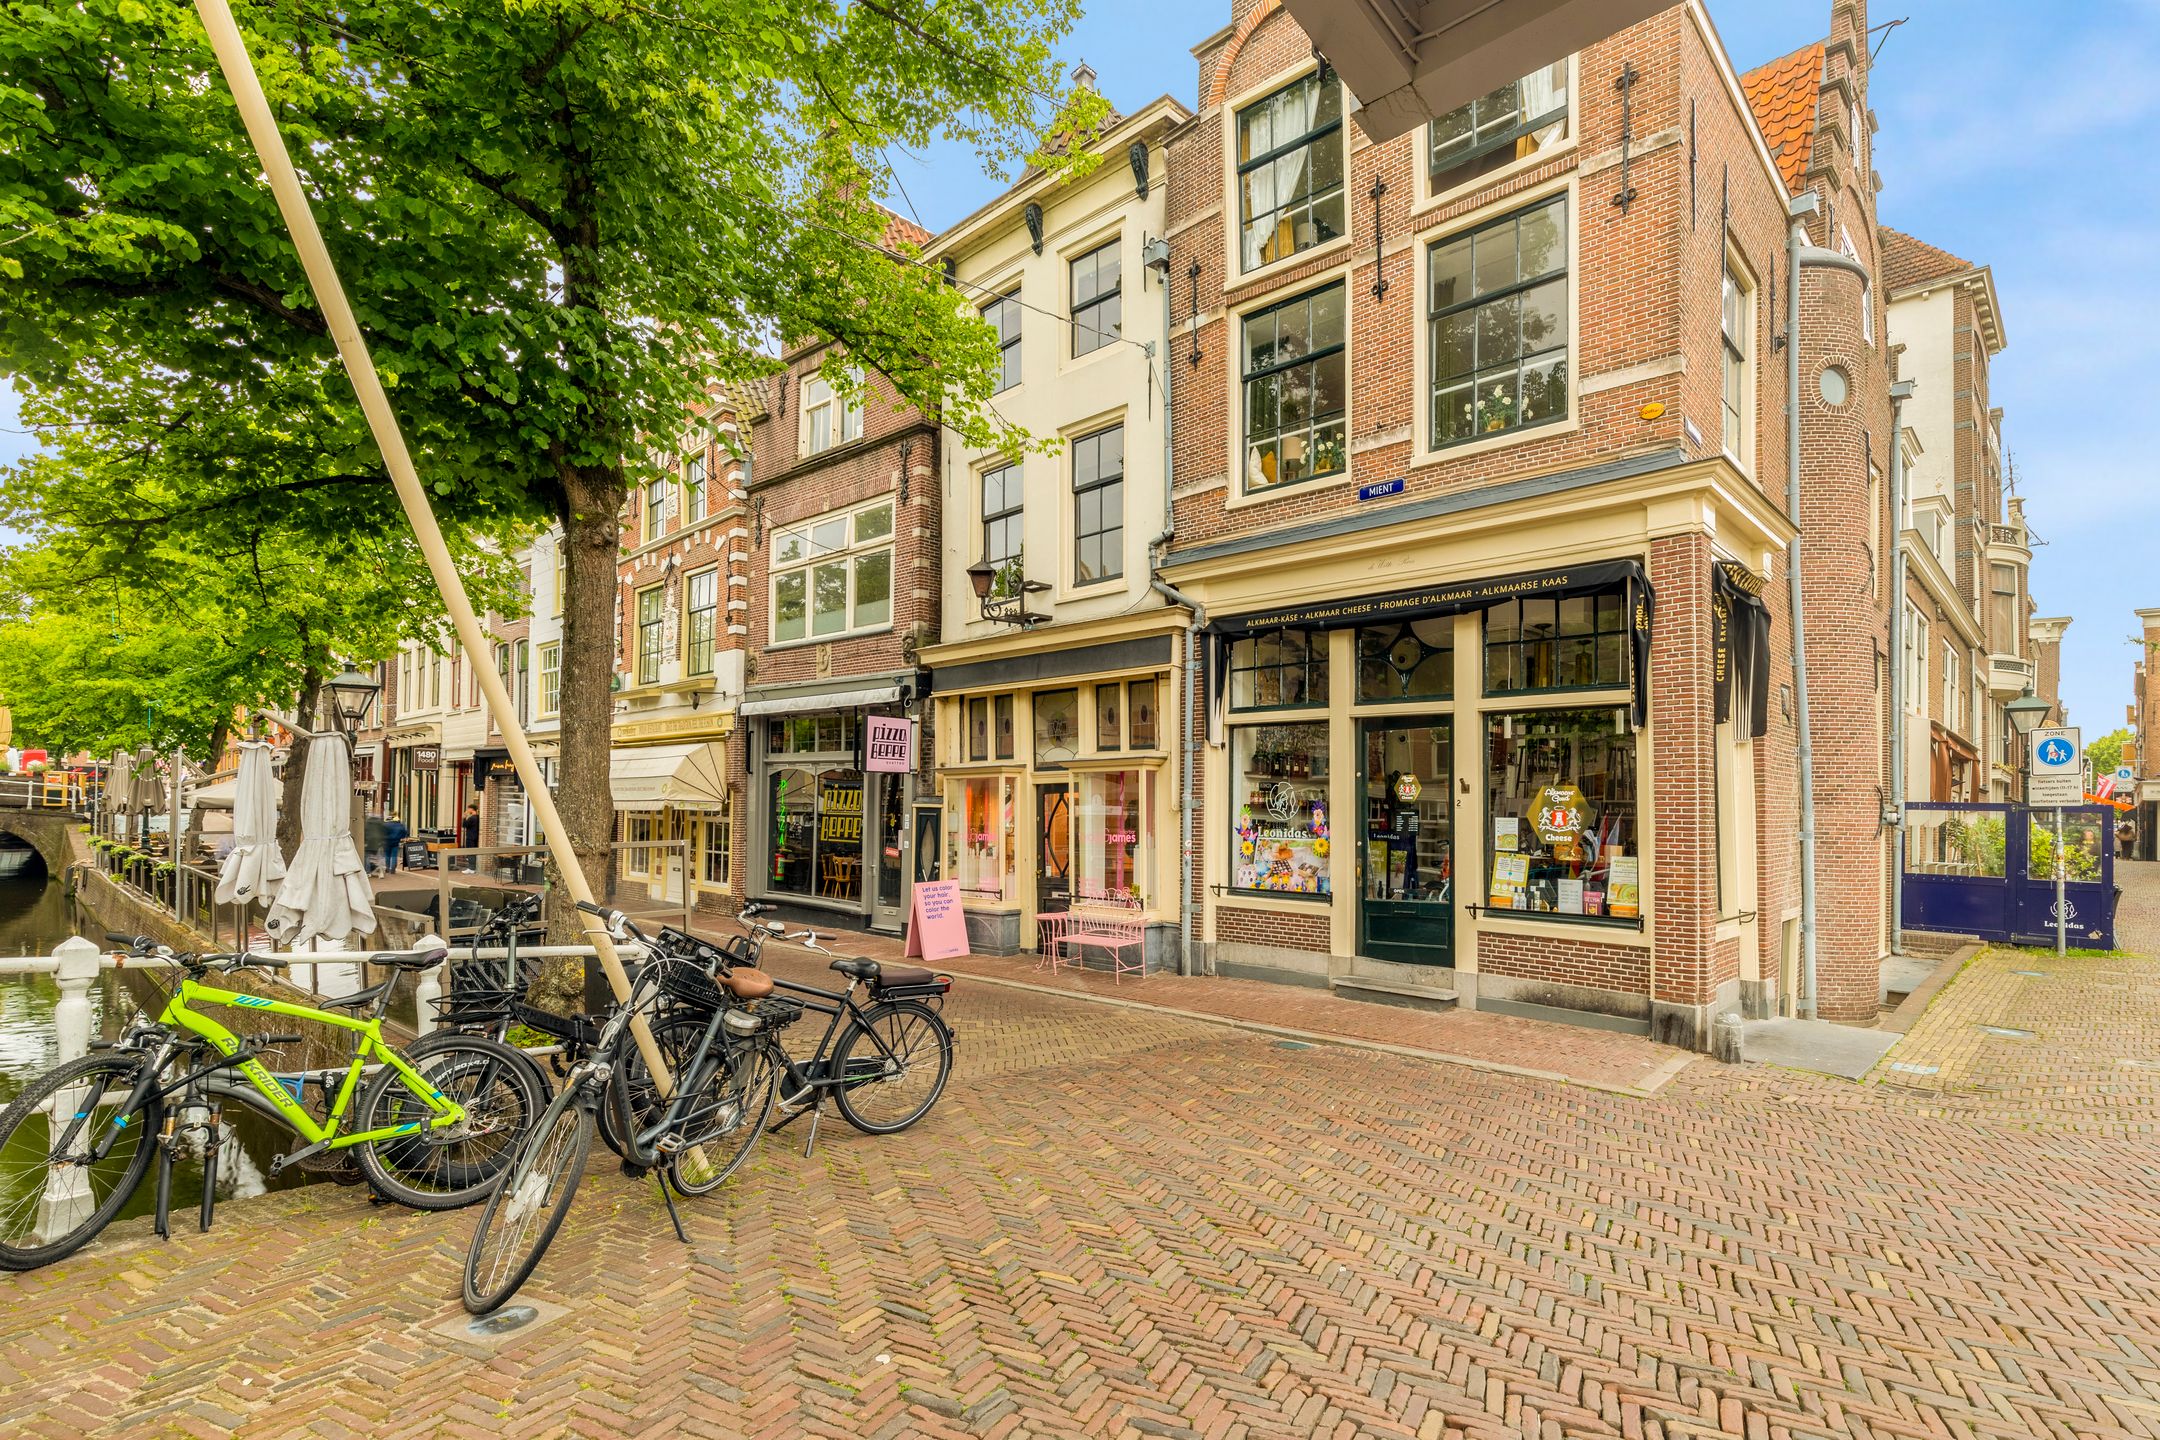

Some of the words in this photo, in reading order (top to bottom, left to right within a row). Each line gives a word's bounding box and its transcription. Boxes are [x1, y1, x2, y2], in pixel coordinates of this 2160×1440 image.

[1368, 482, 1394, 497] MIENT
[1246, 613, 1298, 627] ALKMAAR-KÄSE
[1305, 608, 1340, 620] ALKMAAR
[1342, 603, 1371, 615] CHEESE
[1379, 597, 1420, 610] FROMAGE
[1422, 589, 1472, 604] D'ALKMAAR
[1482, 580, 1538, 596] ALKMAARSE
[1541, 575, 1568, 588] KAAS
[1716, 648, 1726, 682] CHEESE
[1456, 799, 1462, 807] 2
[1257, 826, 1308, 839] Leonidas
[1545, 833, 1573, 842] Cheese
[2044, 920, 2085, 930] Leoidas
